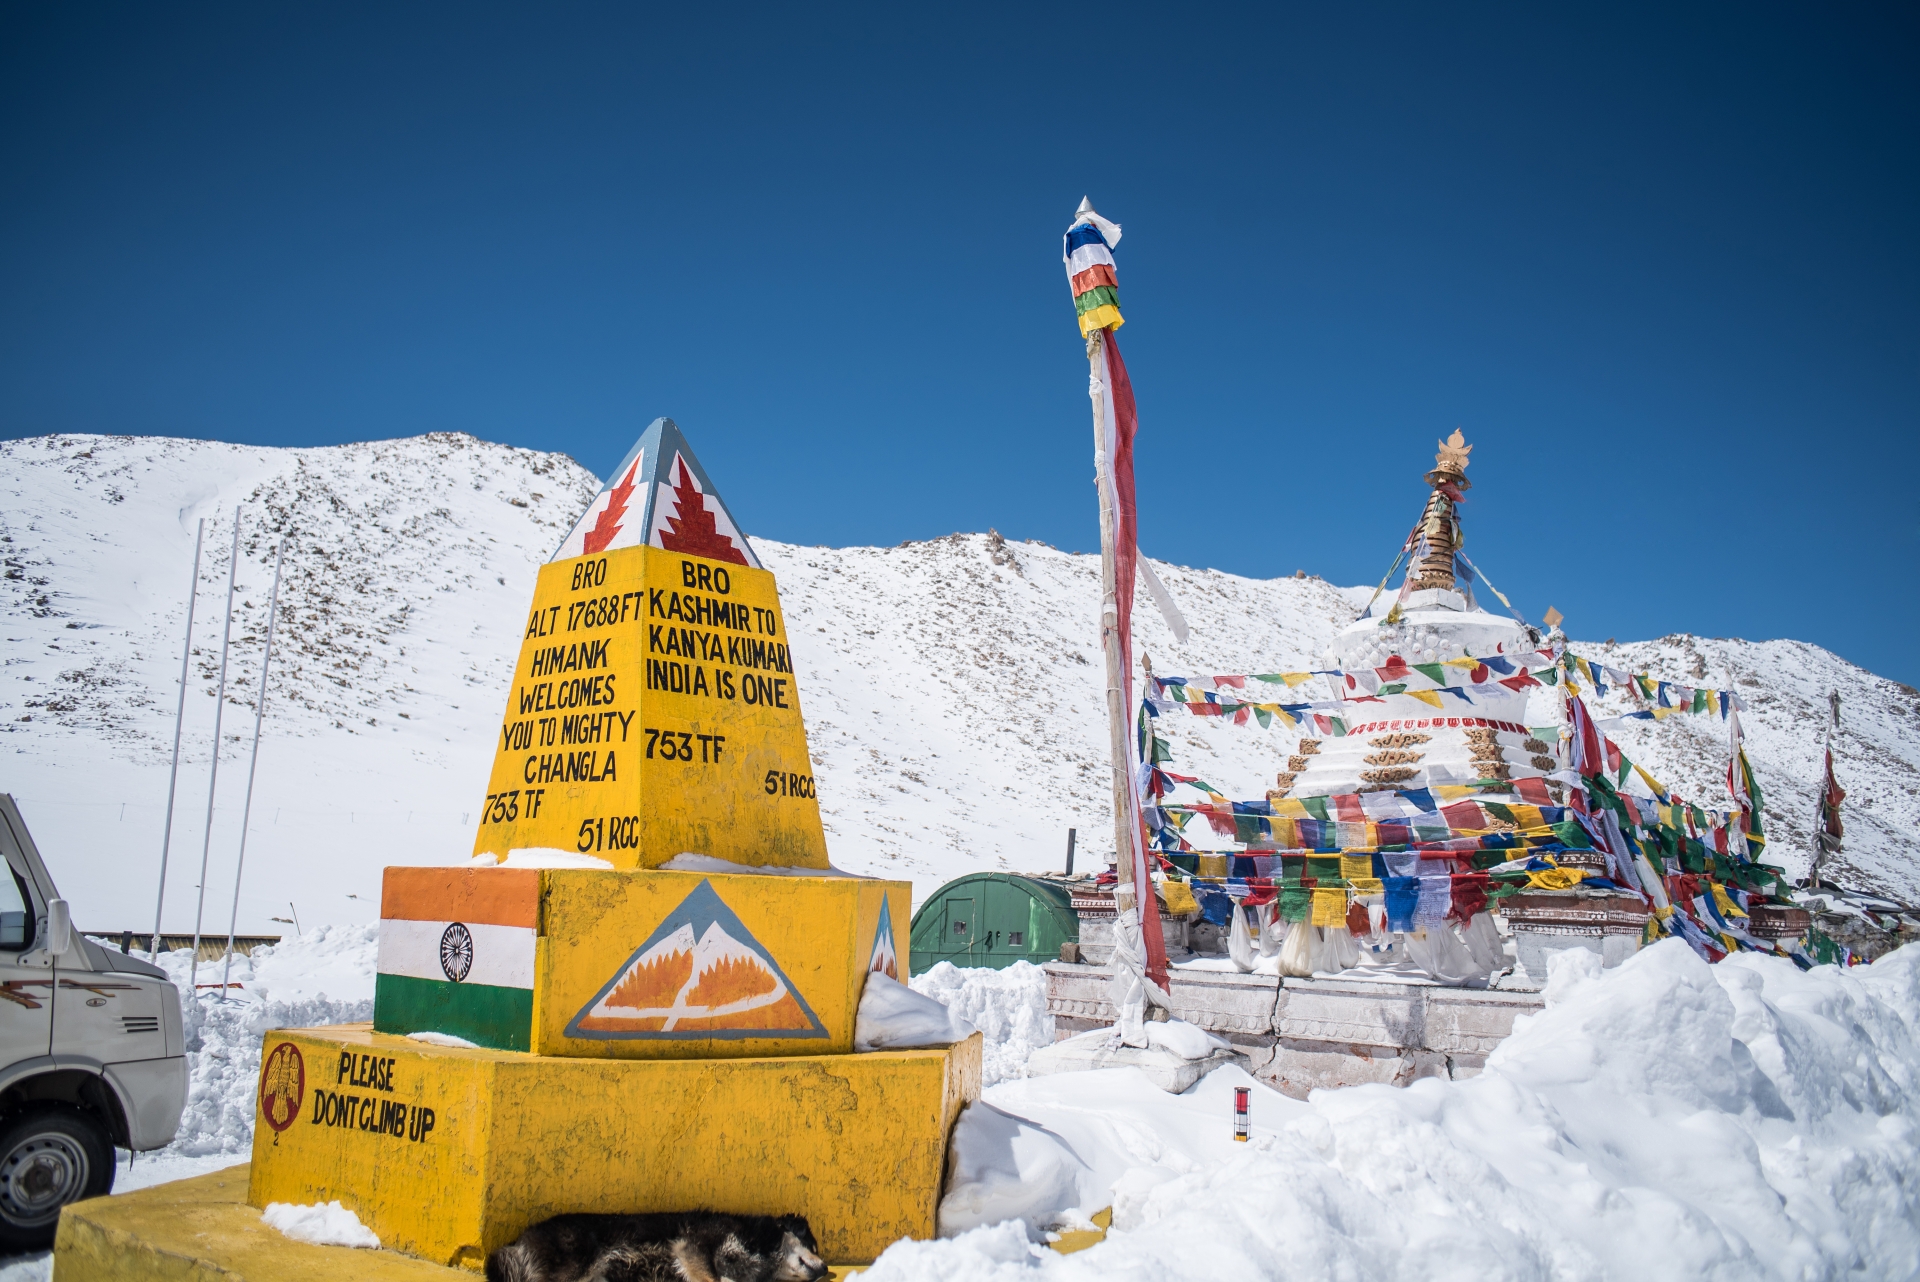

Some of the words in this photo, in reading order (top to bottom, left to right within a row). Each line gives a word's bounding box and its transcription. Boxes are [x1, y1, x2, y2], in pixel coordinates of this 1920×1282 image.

[571, 558, 607, 591] BRO
[682, 560, 731, 595] BRO
[526, 606, 561, 640] ALT
[649, 588, 751, 633] KASHMIR
[753, 607, 776, 637] TO
[530, 638, 612, 679] HIMANK
[649, 624, 725, 667] KANYA
[728, 637, 793, 675] KUMARI
[520, 674, 616, 715] WELCOMES
[646, 658, 710, 697] INDIA
[715, 671, 736, 700] IS
[742, 673, 789, 709] ONE
[503, 721, 533, 752] YOU
[538, 717, 557, 747] TO
[561, 710, 636, 746] MIGHTY
[644, 728, 693, 762] 753
[696, 734, 726, 764] TF
[524, 751, 617, 785] CHANGLA
[764, 770, 787, 796] 51
[789, 773, 816, 799] RCC
[482, 790, 519, 825] 753
[525, 789, 545, 819] TF
[577, 818, 603, 853] 51
[608, 815, 640, 850] RCC
[337, 1051, 396, 1093] PLEASE
[312, 1089, 360, 1129] DONT
[359, 1097, 408, 1139] CLIMB
[409, 1106, 436, 1144] UP
